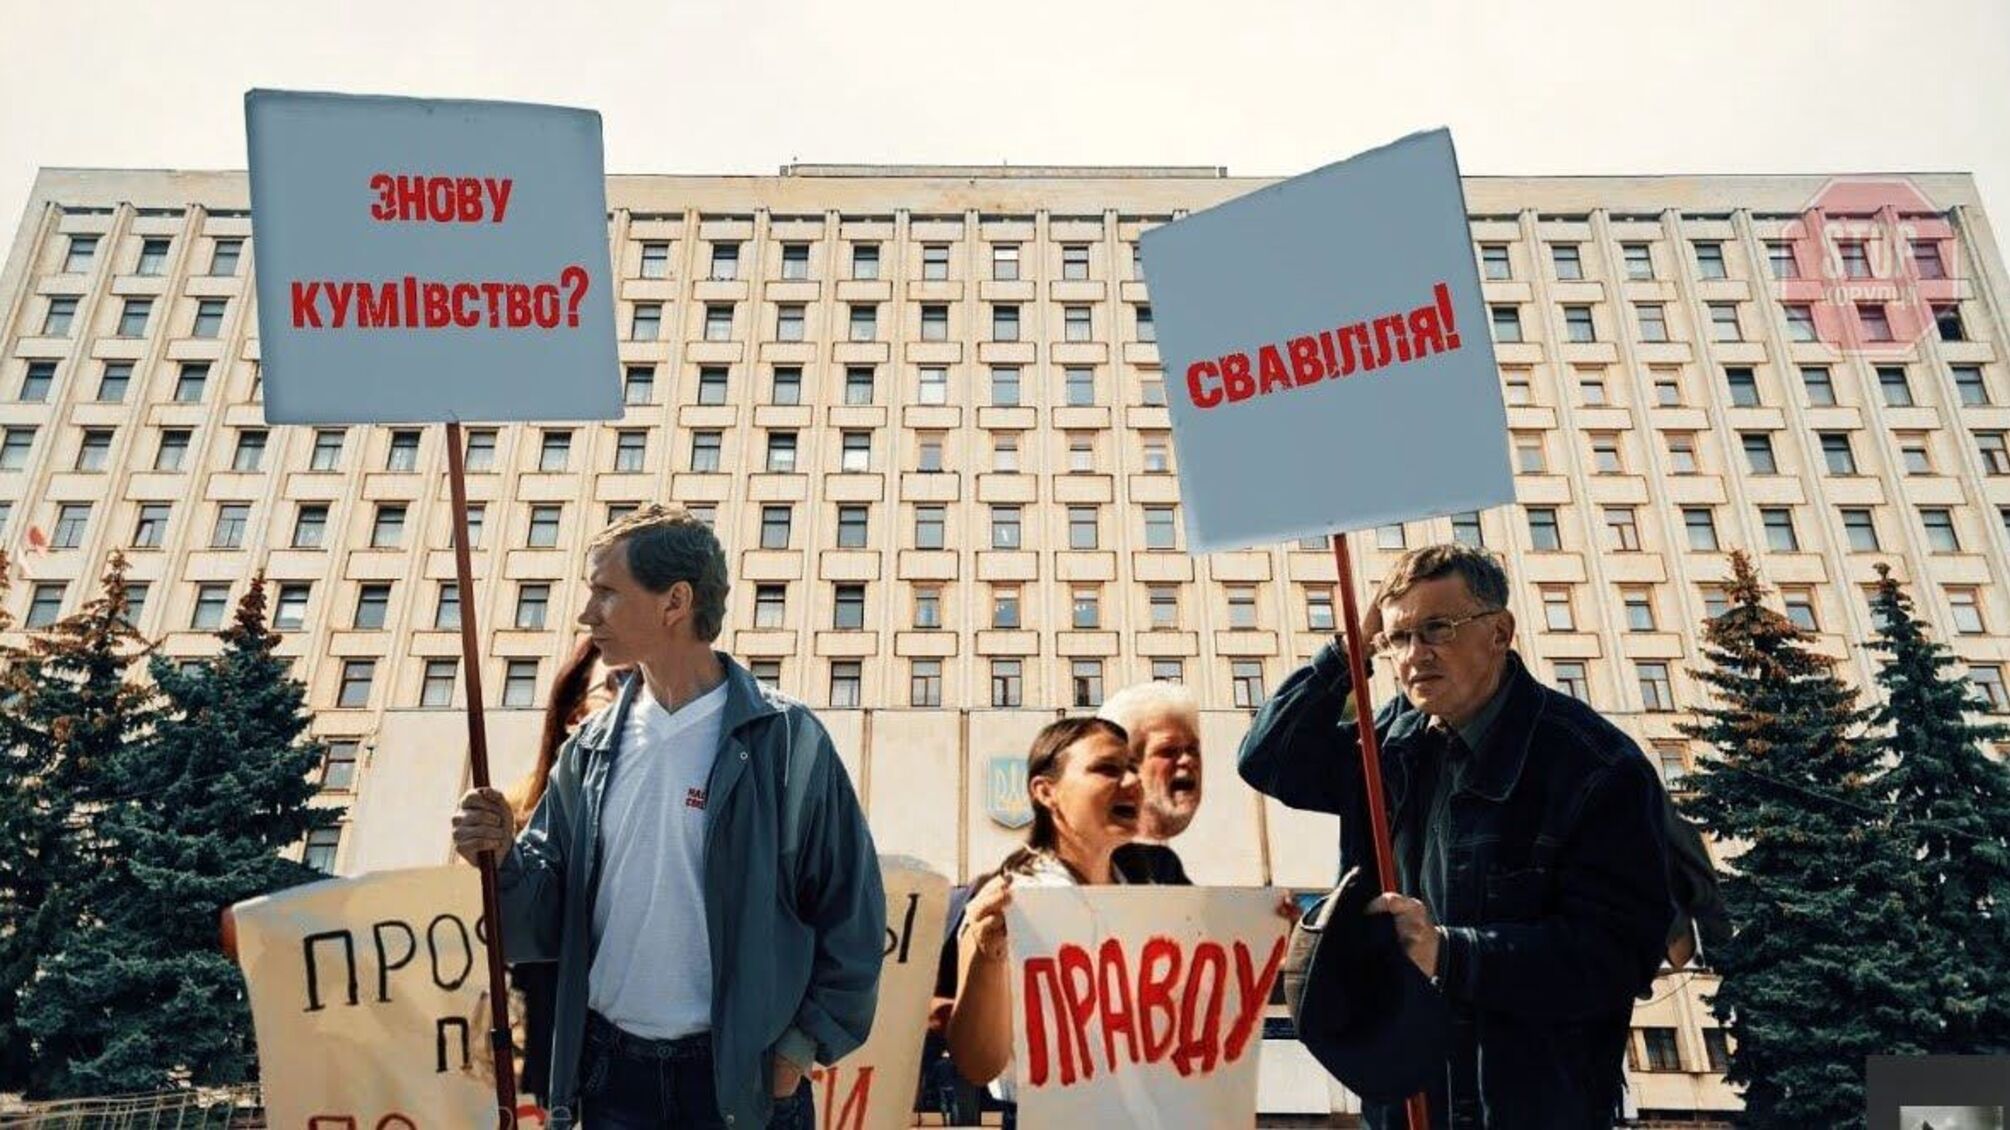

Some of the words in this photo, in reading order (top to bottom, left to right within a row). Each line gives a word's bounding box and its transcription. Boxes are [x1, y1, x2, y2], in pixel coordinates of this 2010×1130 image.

[368, 172, 514, 224] ЗНОВУ
[290, 265, 591, 329] КУМІВСТВО?
[1186, 282, 1463, 409] СВАВІЛЛЯ!
[1023, 935, 1287, 1087] ПРАВДУ
